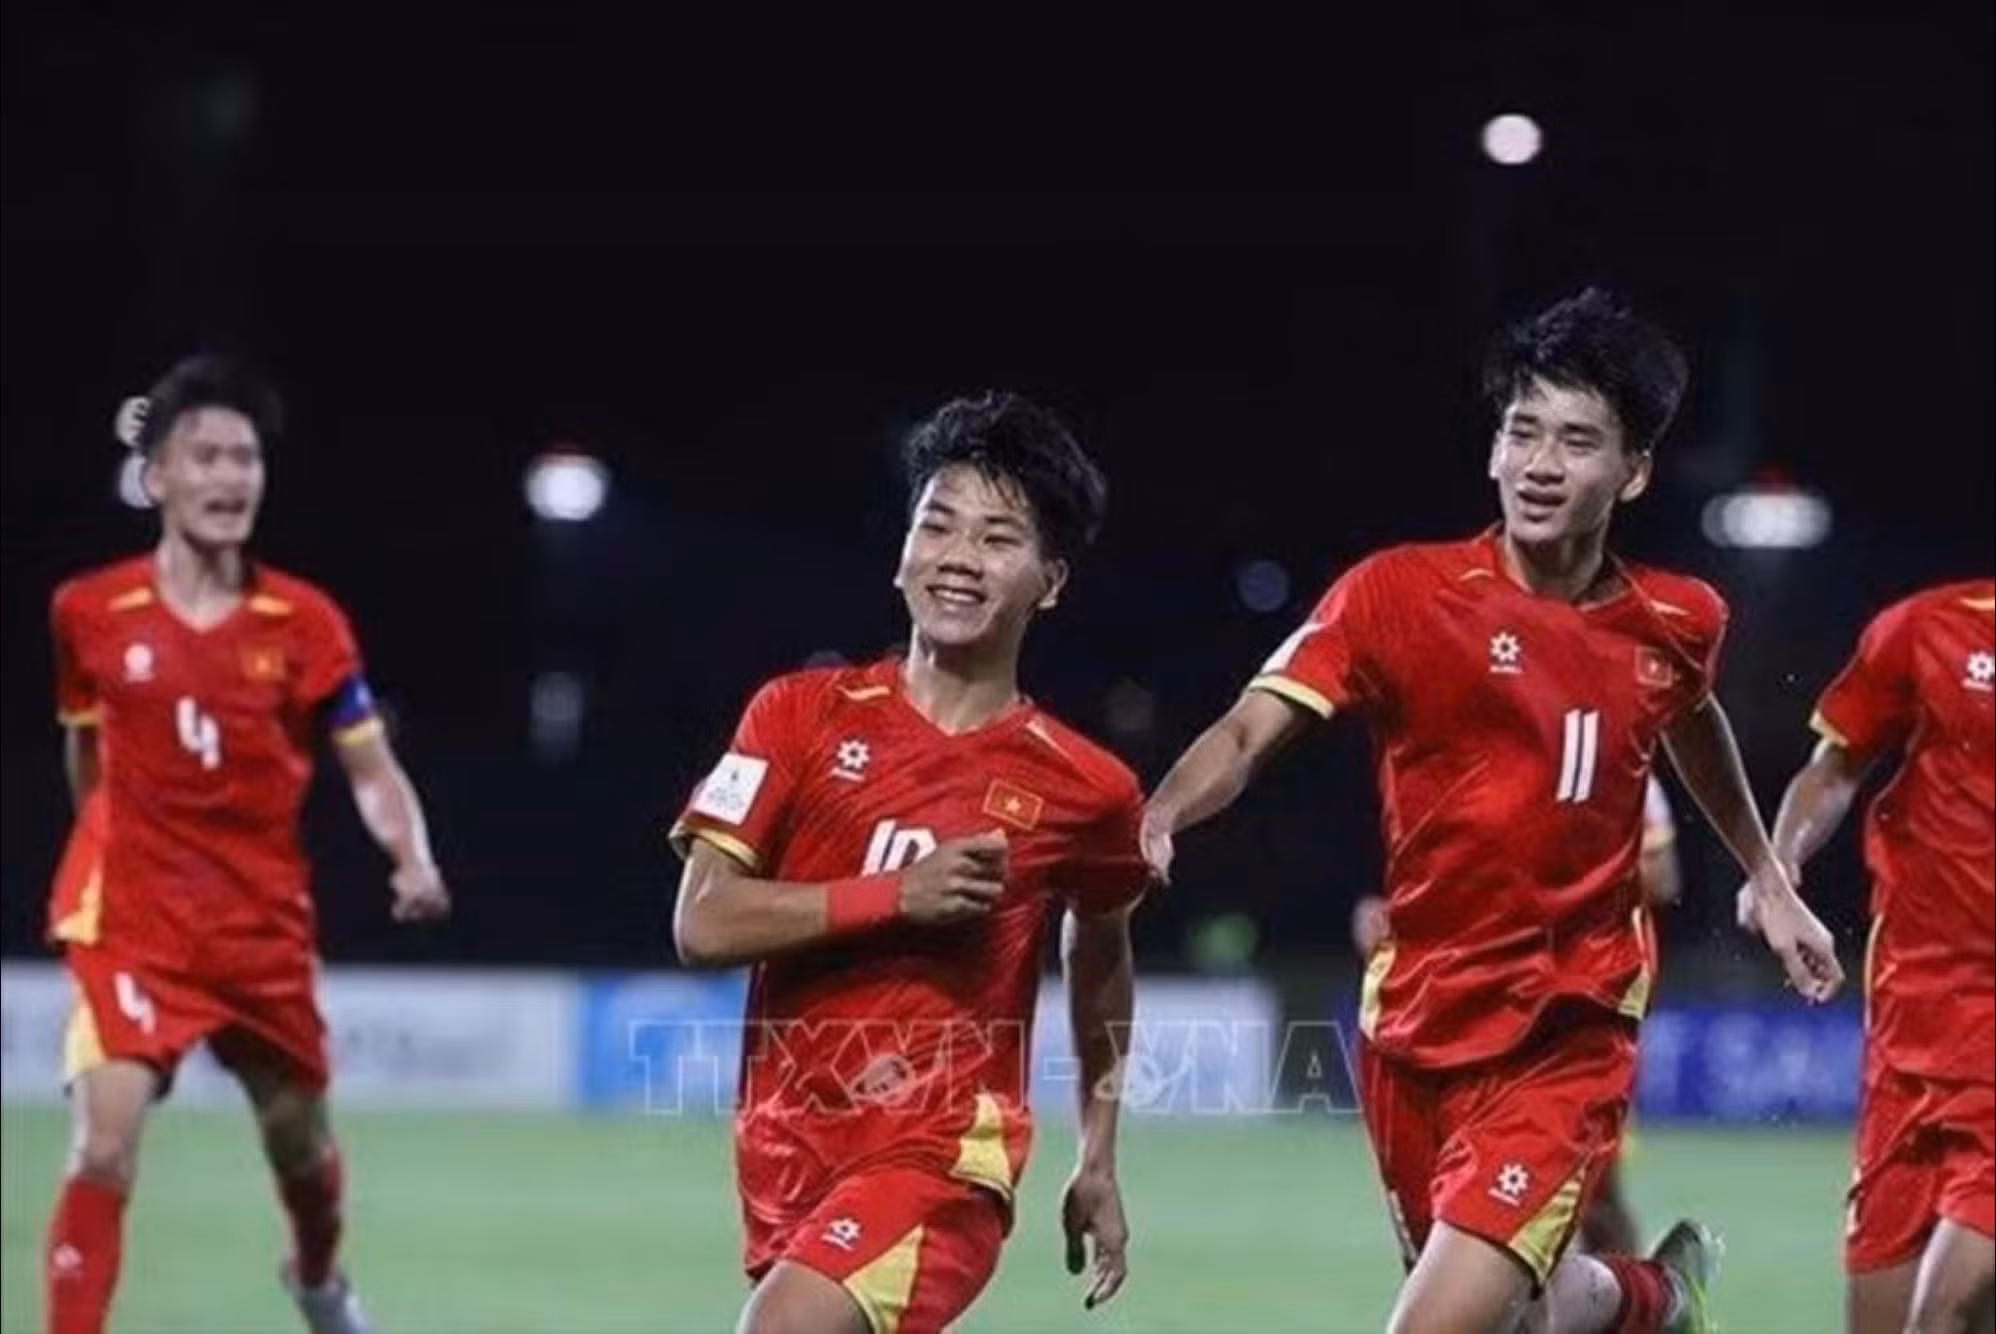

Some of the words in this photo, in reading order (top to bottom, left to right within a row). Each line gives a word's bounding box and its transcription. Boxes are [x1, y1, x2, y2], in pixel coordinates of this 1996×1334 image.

[175, 696, 220, 771] 4
[1556, 709, 1599, 803] 11
[115, 971, 156, 1034] 4
